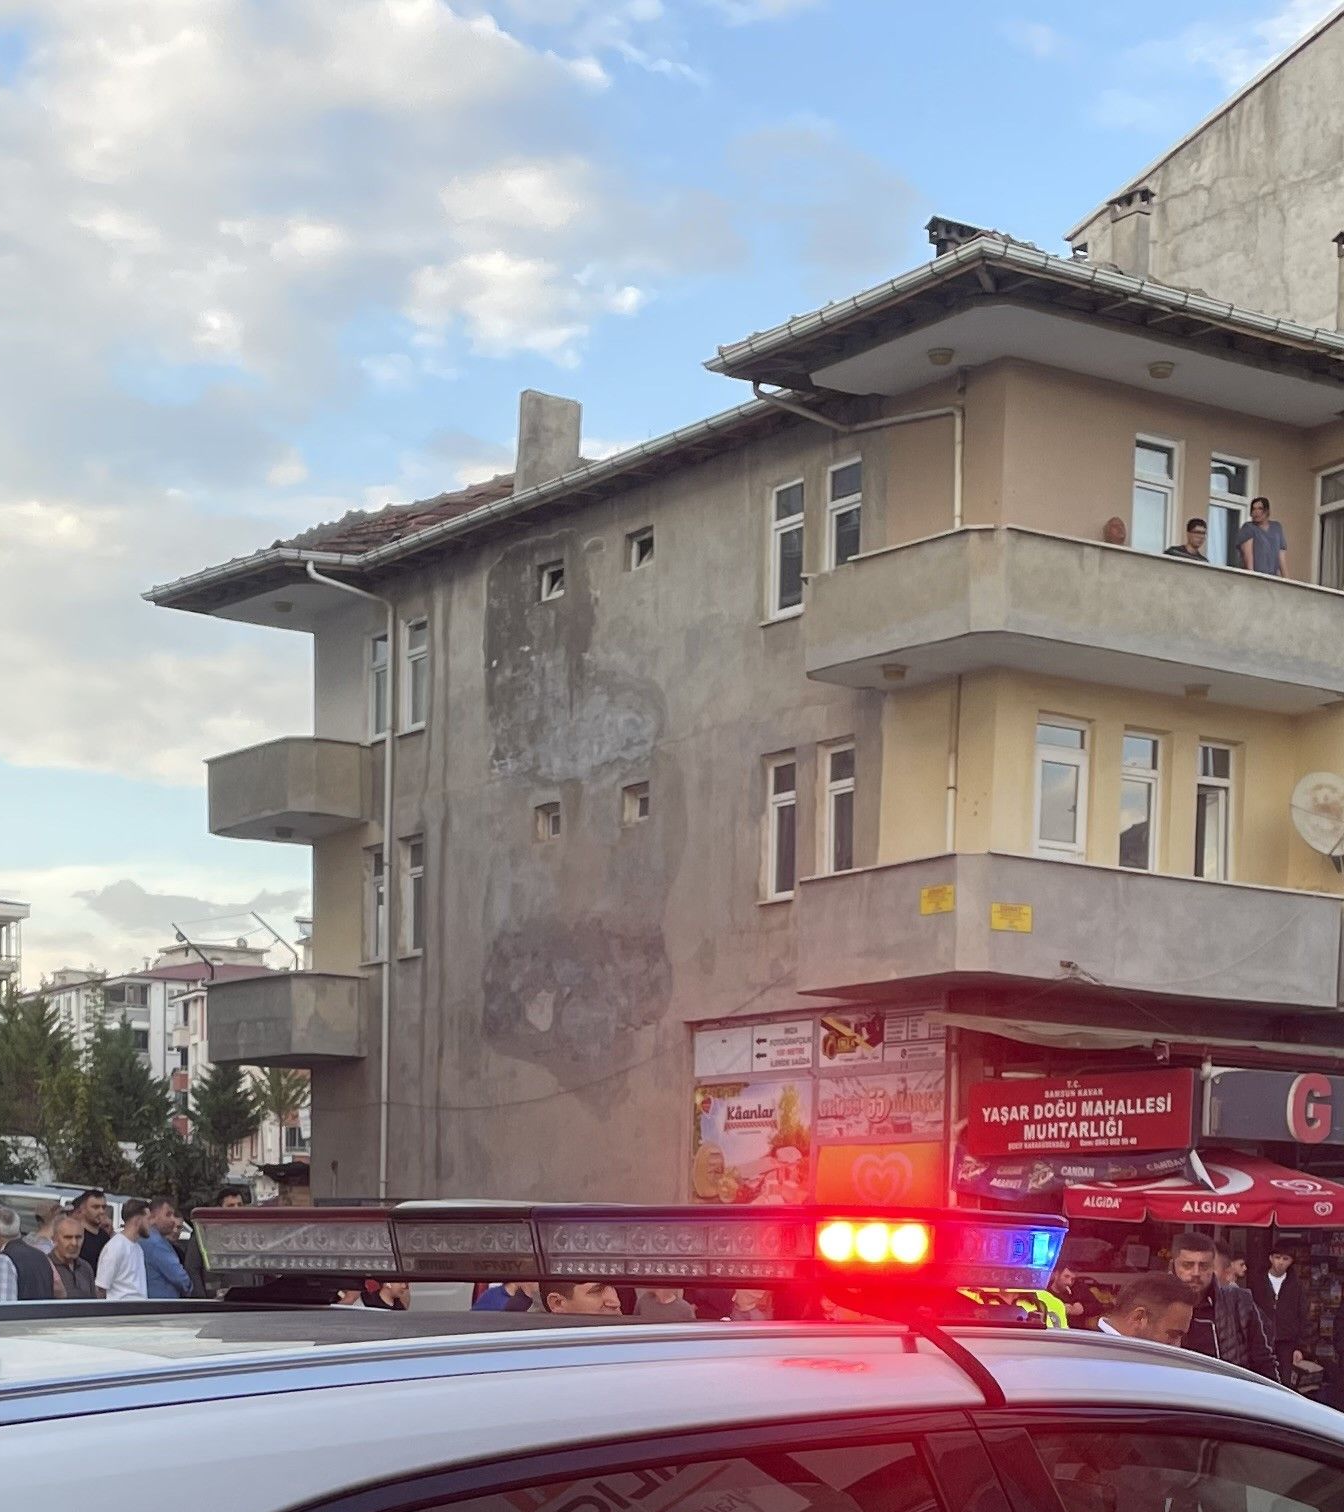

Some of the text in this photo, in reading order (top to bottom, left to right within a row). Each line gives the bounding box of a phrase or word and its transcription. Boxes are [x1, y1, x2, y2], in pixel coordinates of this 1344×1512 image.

[726, 1104, 776, 1121] Kâanlar
[982, 1092, 1172, 1126] YAŞAR DOĞU MAHALLESİ
[1023, 1117, 1123, 1141] MUHTARLIĞI
